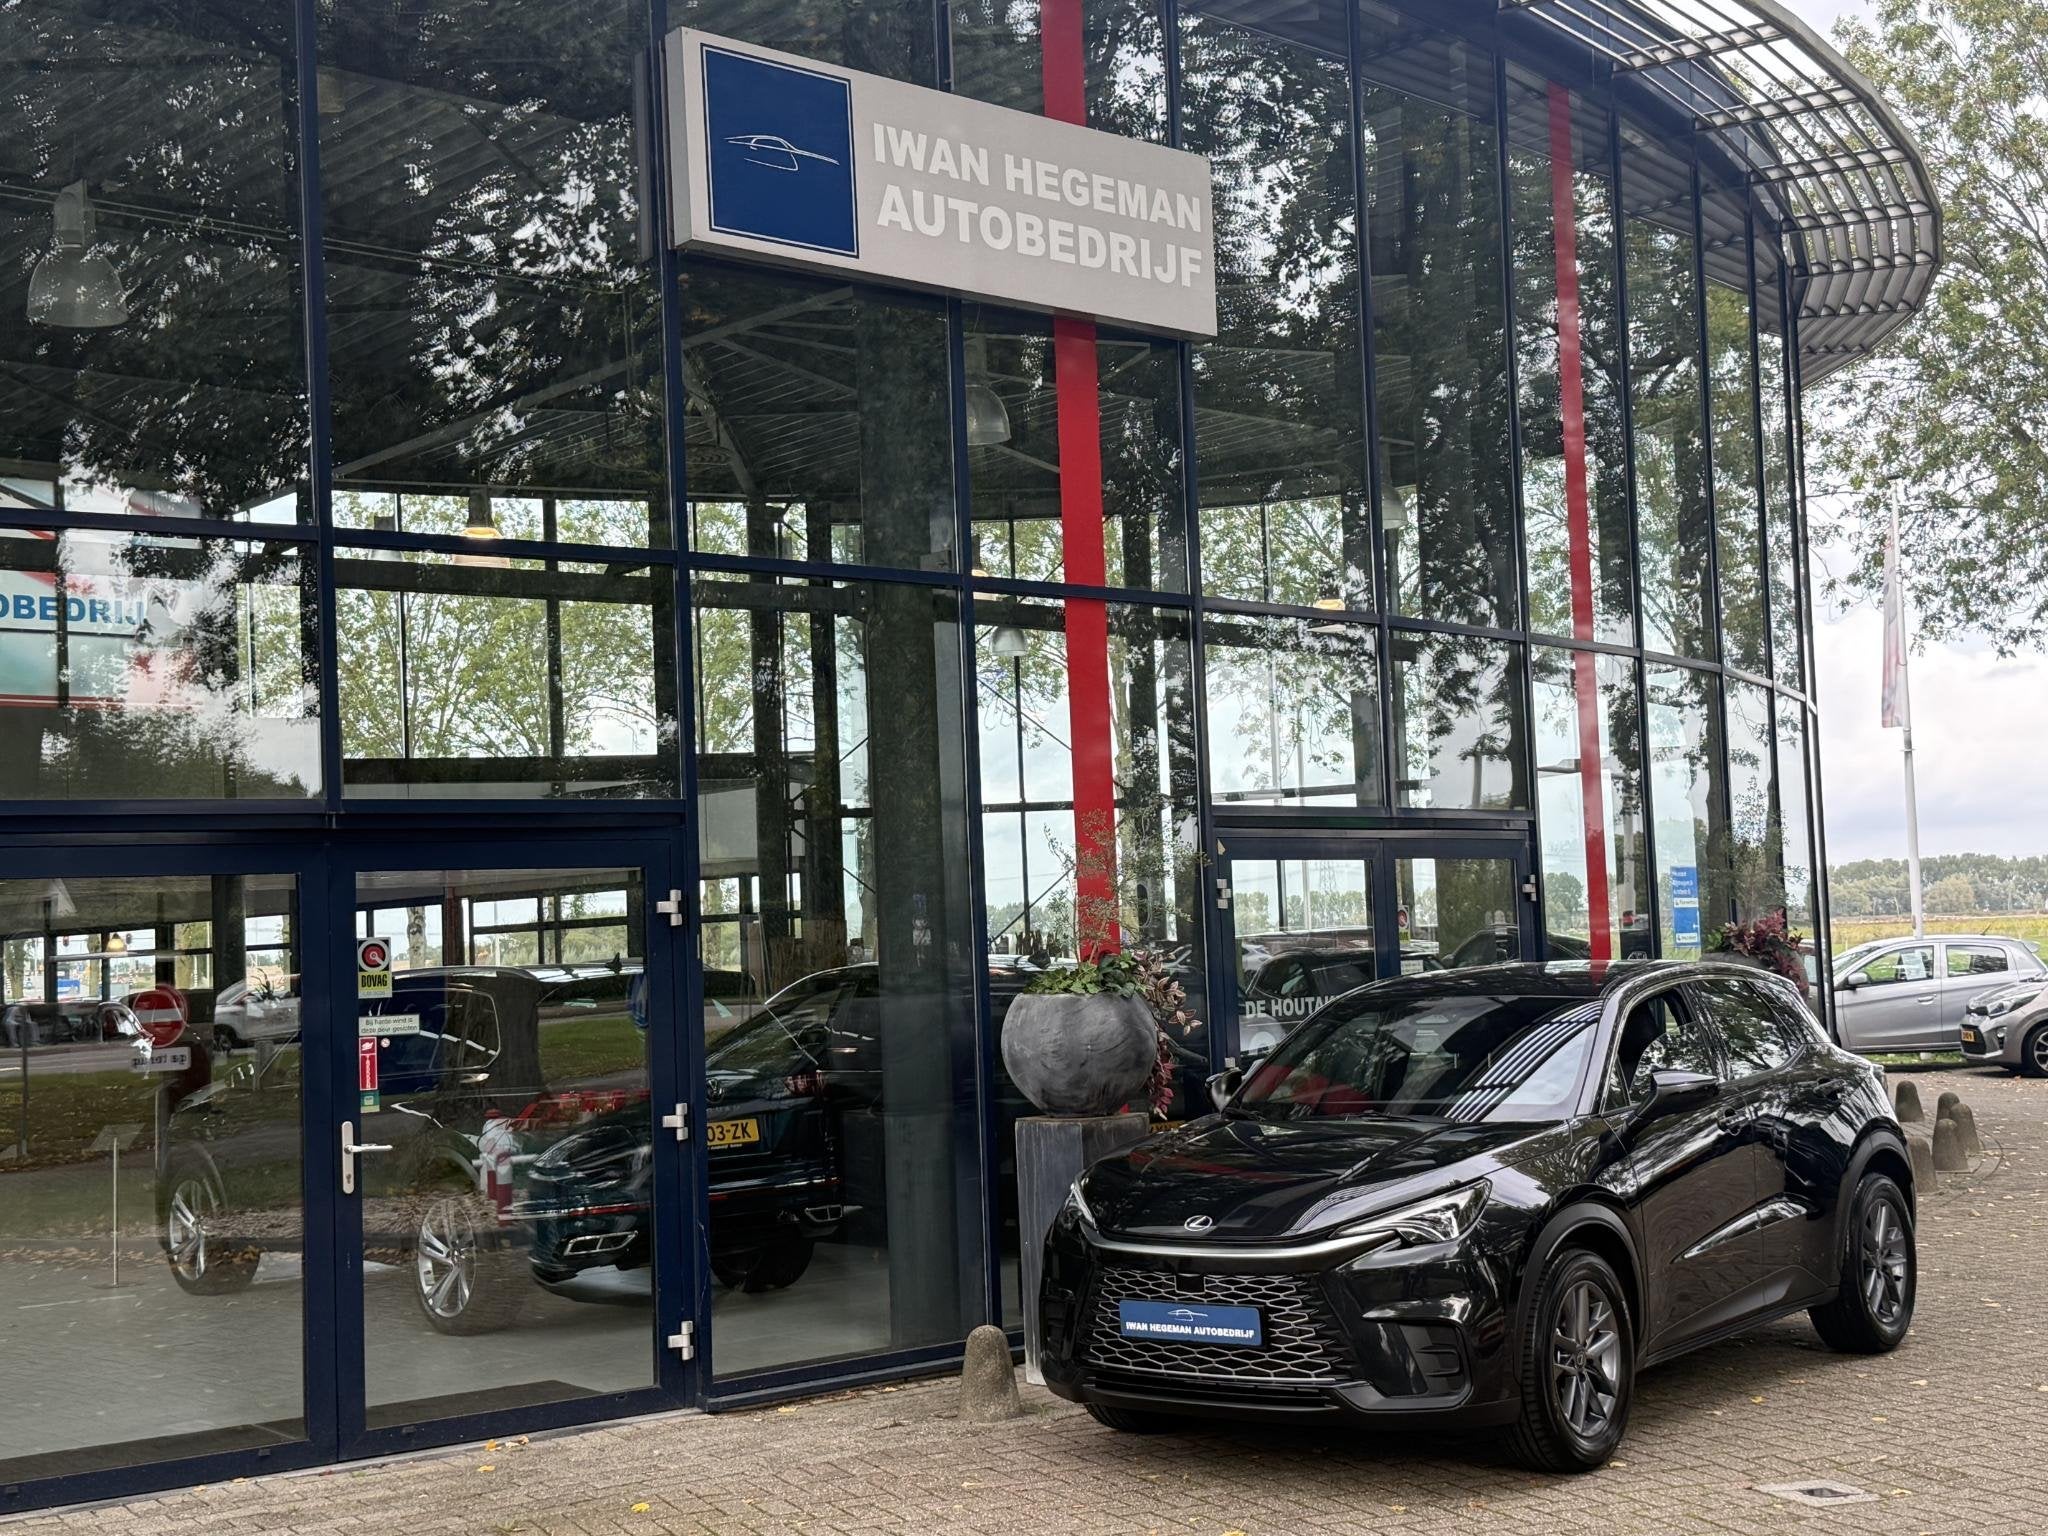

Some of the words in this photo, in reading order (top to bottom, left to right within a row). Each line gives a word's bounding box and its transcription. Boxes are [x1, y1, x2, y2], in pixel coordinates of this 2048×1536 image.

[873, 122, 990, 186] IWAN
[1004, 153, 1201, 233] HEGEMAN
[877, 184, 1202, 287] AUTOBEDRIJF
[1245, 1000, 1266, 1018] DE
[1125, 1321, 1148, 1332] IWAN
[1149, 1323, 1192, 1335] HEGEMAN
[1193, 1326, 1255, 1339] AUTOBEDRIJF
